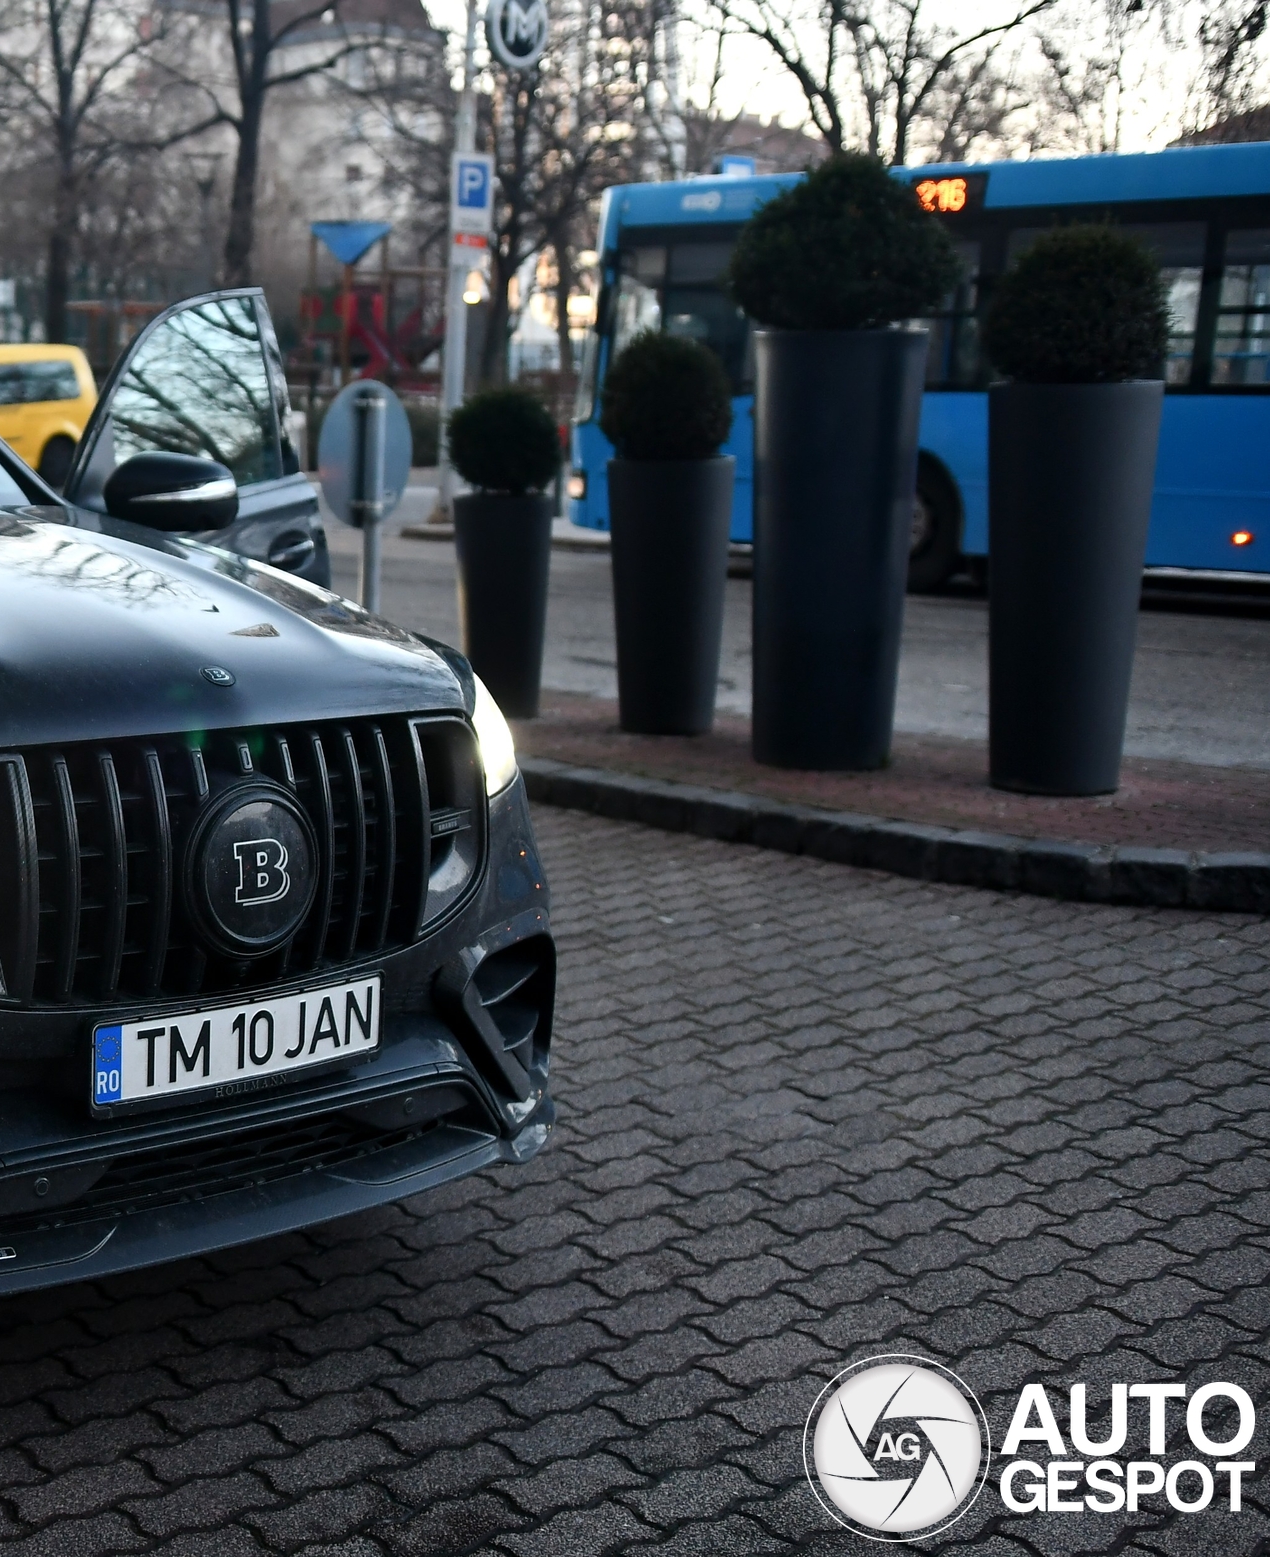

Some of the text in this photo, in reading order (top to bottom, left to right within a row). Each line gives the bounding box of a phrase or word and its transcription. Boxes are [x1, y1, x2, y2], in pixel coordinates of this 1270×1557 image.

[463, 166, 484, 201] P
[916, 178, 967, 212] 216
[233, 838, 292, 907] B
[137, 985, 374, 1087] TM 10 JAN
[97, 1069, 121, 1096] RO
[215, 1074, 288, 1098] HOLLMANN
